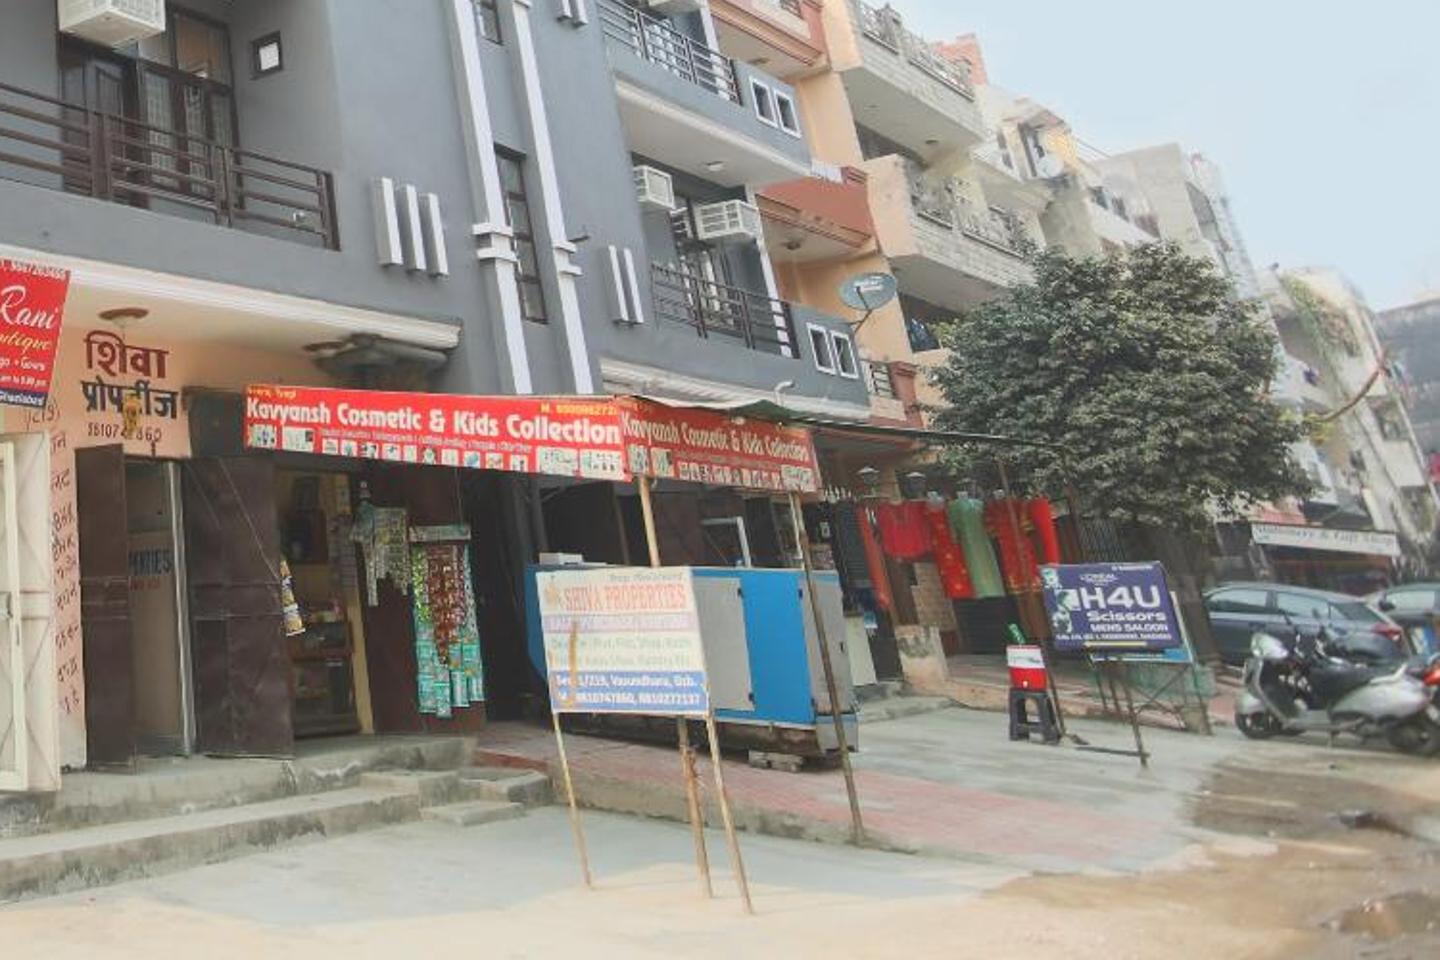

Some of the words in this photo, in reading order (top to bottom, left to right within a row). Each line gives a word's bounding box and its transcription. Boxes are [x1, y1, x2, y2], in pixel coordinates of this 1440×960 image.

[83, 330, 169, 379] शिवा
[246, 397, 331, 427] Kavyansh
[337, 403, 422, 430] Cosmetic
[429, 408, 446, 433] &
[454, 410, 499, 437] Kids
[506, 414, 620, 445] Collection
[681, 422, 729, 449] Cosmetic
[731, 429, 740, 452] &
[563, 584, 601, 612] SHIVA
[604, 583, 687, 610] PROPERTIES
[1079, 585, 1161, 610] H4U
[1086, 610, 1167, 622] Scissors
